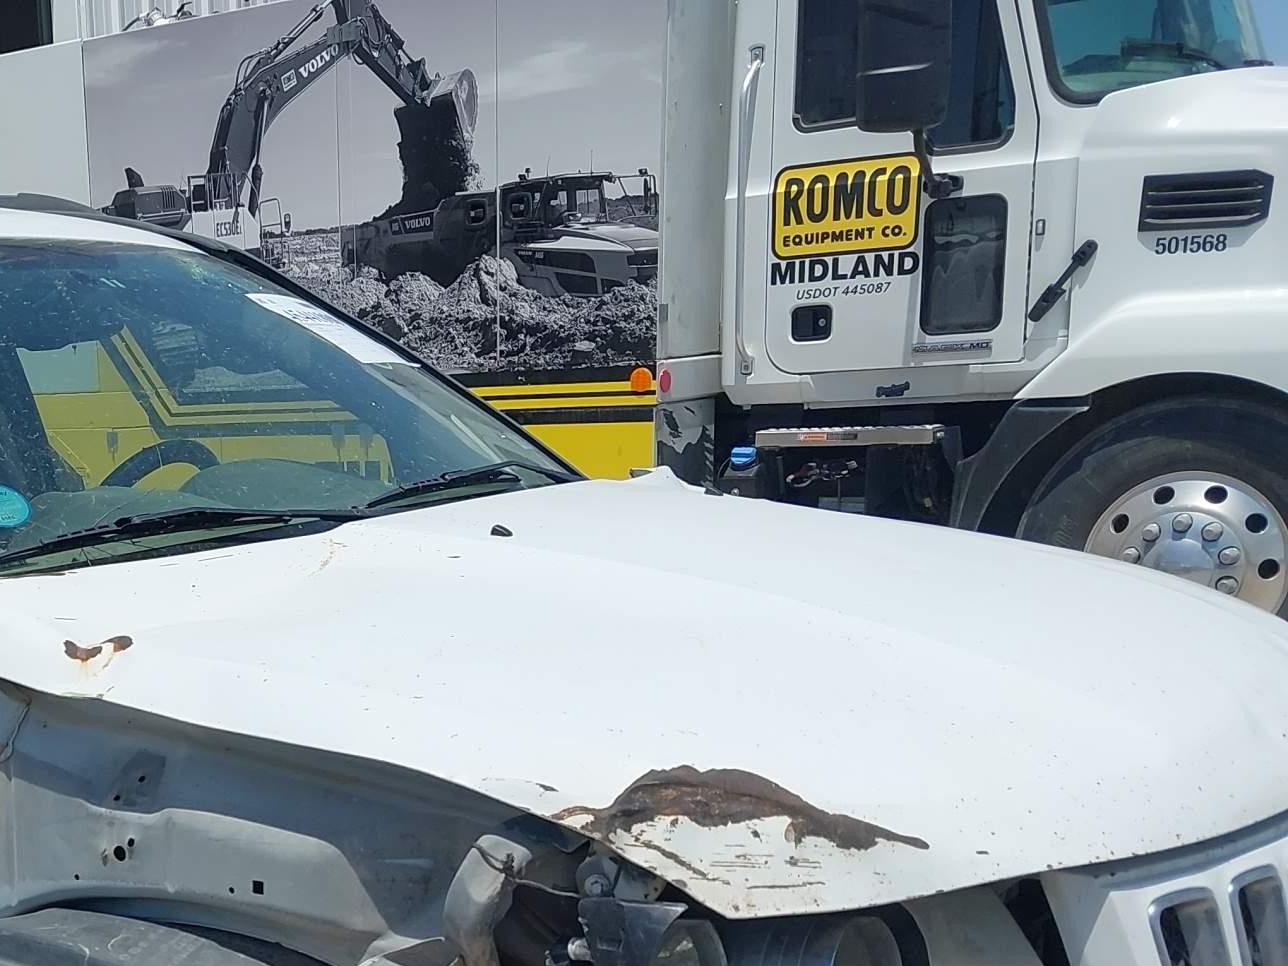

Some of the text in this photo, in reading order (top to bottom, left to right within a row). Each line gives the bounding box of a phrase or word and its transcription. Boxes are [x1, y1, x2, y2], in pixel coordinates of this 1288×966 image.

[298, 44, 339, 78] VOLVO
[783, 165, 912, 227] ROMCO
[404, 216, 431, 230] VOLVO
[782, 224, 908, 248] EQUIPMENT CO.
[1154, 233, 1228, 255] 501568
[770, 251, 920, 286] MIDLAND
[796, 282, 891, 300] USDOT 445087
